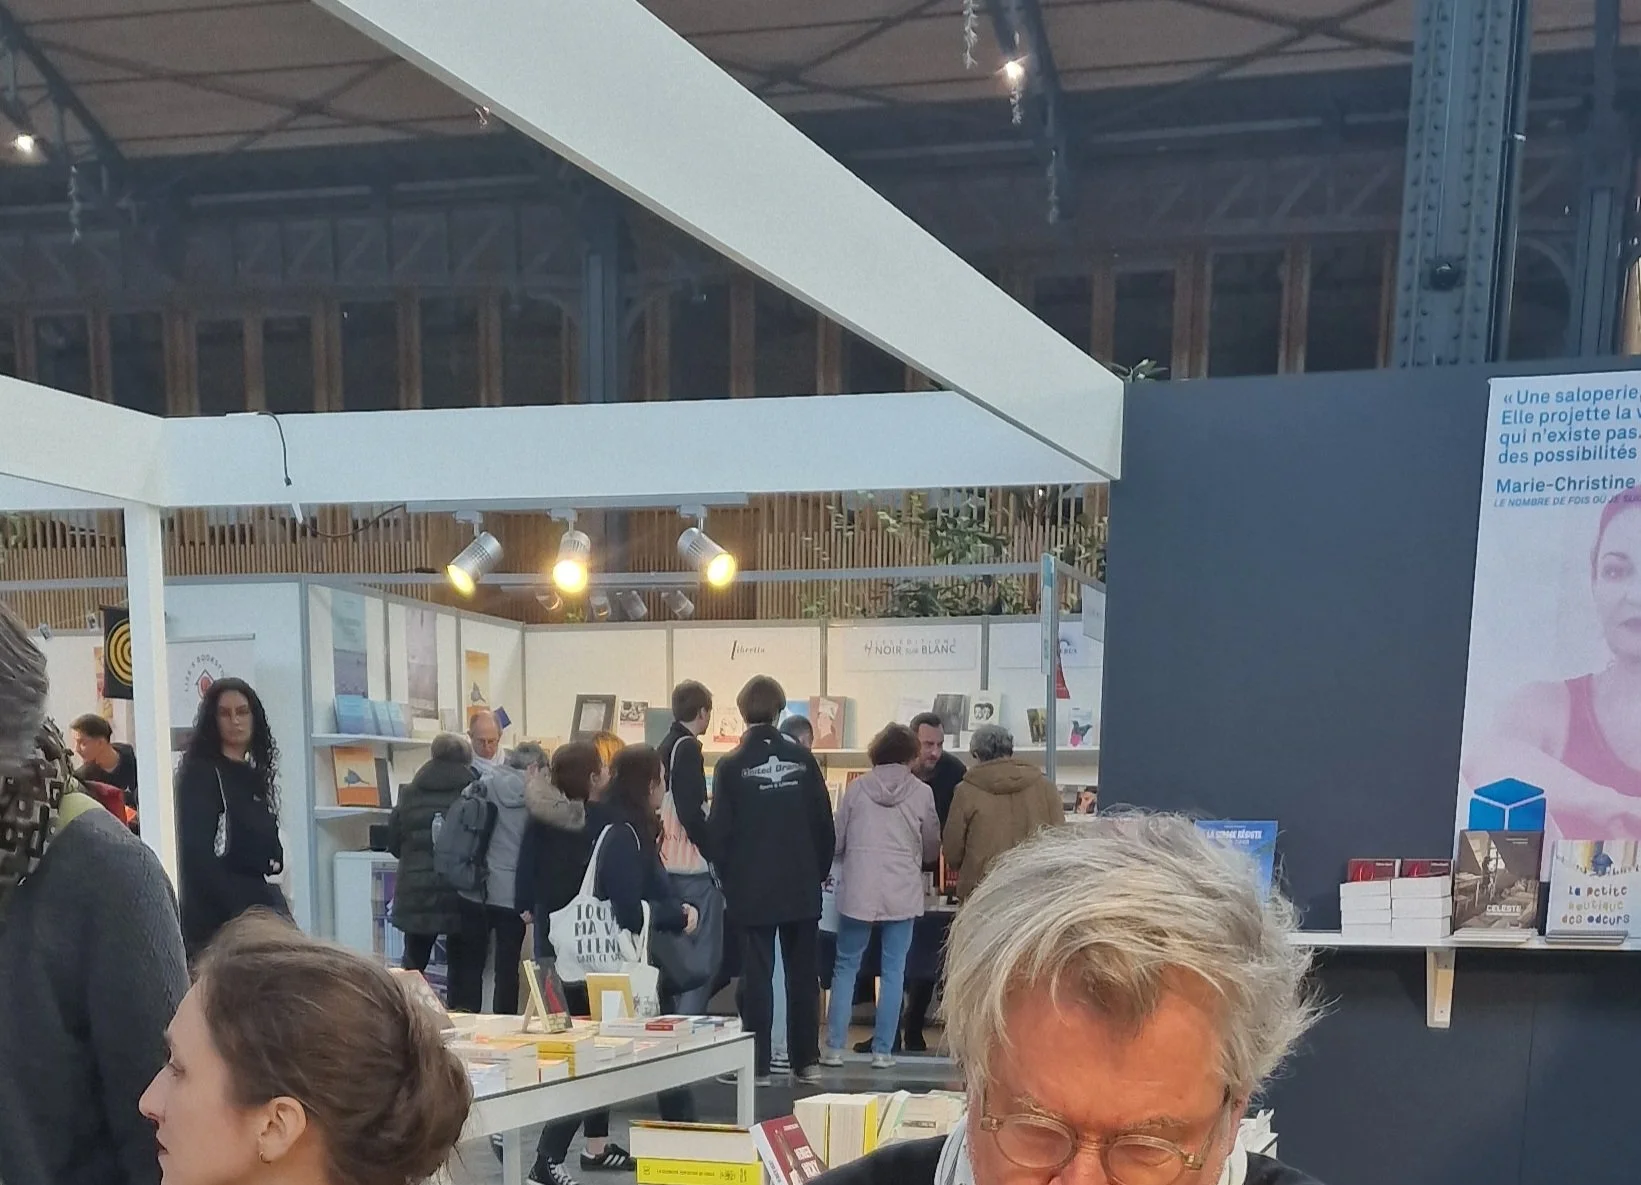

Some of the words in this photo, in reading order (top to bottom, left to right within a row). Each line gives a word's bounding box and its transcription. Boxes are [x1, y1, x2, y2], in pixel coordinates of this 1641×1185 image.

[1517, 389, 1550, 405] Une
[1501, 409, 1534, 426] Elle
[1539, 405, 1610, 427] projette
[1616, 404, 1631, 420] la
[1499, 428, 1526, 448] qui
[1498, 448, 1529, 464] des
[1534, 444, 1638, 466] possibilités
[1496, 474, 1636, 494] Marie-Christine
[1508, 497, 1550, 507] NOMBRE
[1552, 496, 1566, 506] DE
[1568, 496, 1590, 505] FOIS
[876, 645, 902, 655] NOIR
[921, 644, 957, 654] BLANC
[576, 904, 616, 922] TOU
[574, 921, 597, 936] MA
